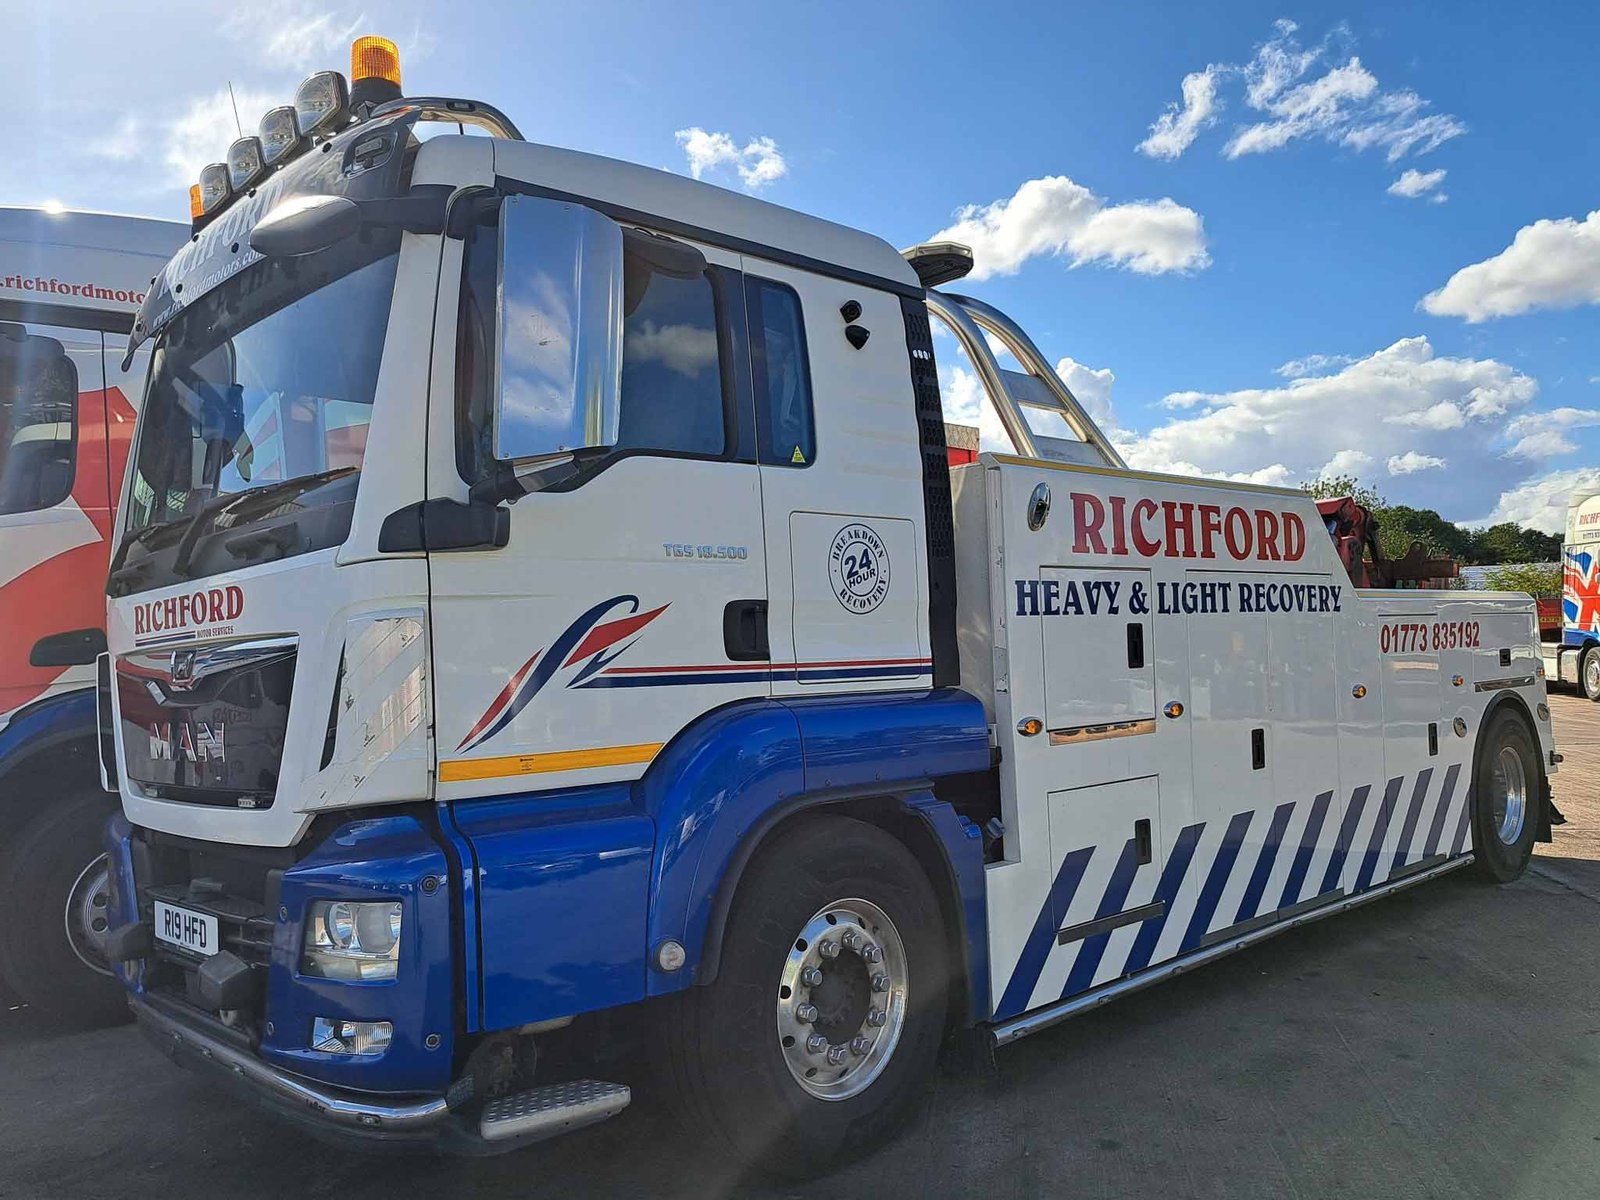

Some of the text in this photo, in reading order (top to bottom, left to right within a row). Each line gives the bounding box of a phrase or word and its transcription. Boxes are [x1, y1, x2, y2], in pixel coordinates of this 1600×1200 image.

[1070, 492, 1306, 562] RICHFORD
[662, 543, 748, 560] TGS 18.500
[832, 528, 885, 561] BREAKDOWN
[844, 547, 873, 580] 24
[848, 568, 876, 588] HOUR
[840, 575, 886, 609] RECOVERY
[1015, 580, 1342, 616] HEAVY & LIGHT RECOVERY
[134, 585, 244, 635] RICHFORD
[1380, 621, 1480, 653] 01773 835192
[149, 722, 225, 763] MAN
[164, 908, 207, 949] R19 HFD
